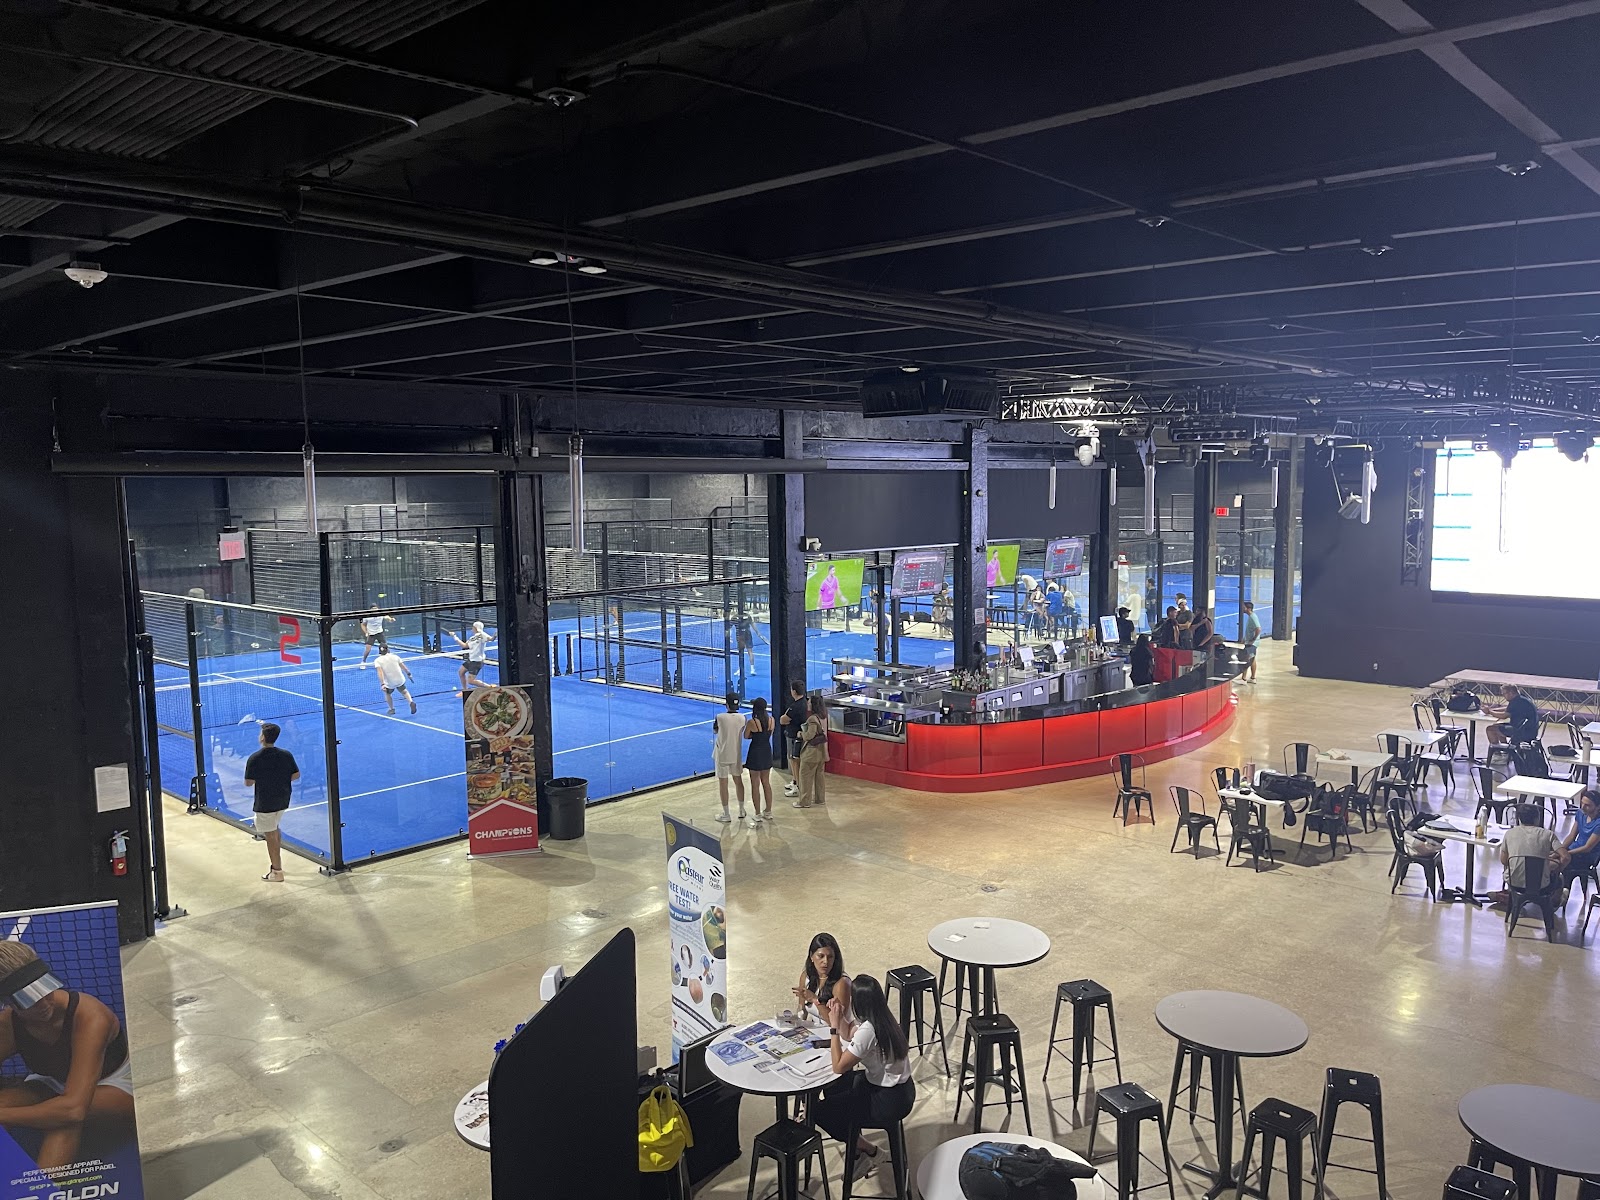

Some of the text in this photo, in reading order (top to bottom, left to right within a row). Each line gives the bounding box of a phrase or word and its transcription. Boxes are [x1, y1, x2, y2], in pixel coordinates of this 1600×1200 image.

[278, 615, 302, 664] 2
[675, 894, 691, 910] TEST!
[679, 886, 699, 904] WATER
[10, 1163, 116, 1186] SPECIALLY DESIGNED FOR PADEL
[23, 1159, 103, 1177] PERFORMANCE APPAREL
[29, 1183, 46, 1191] SHOP
[48, 1181, 120, 1200] GLDN
